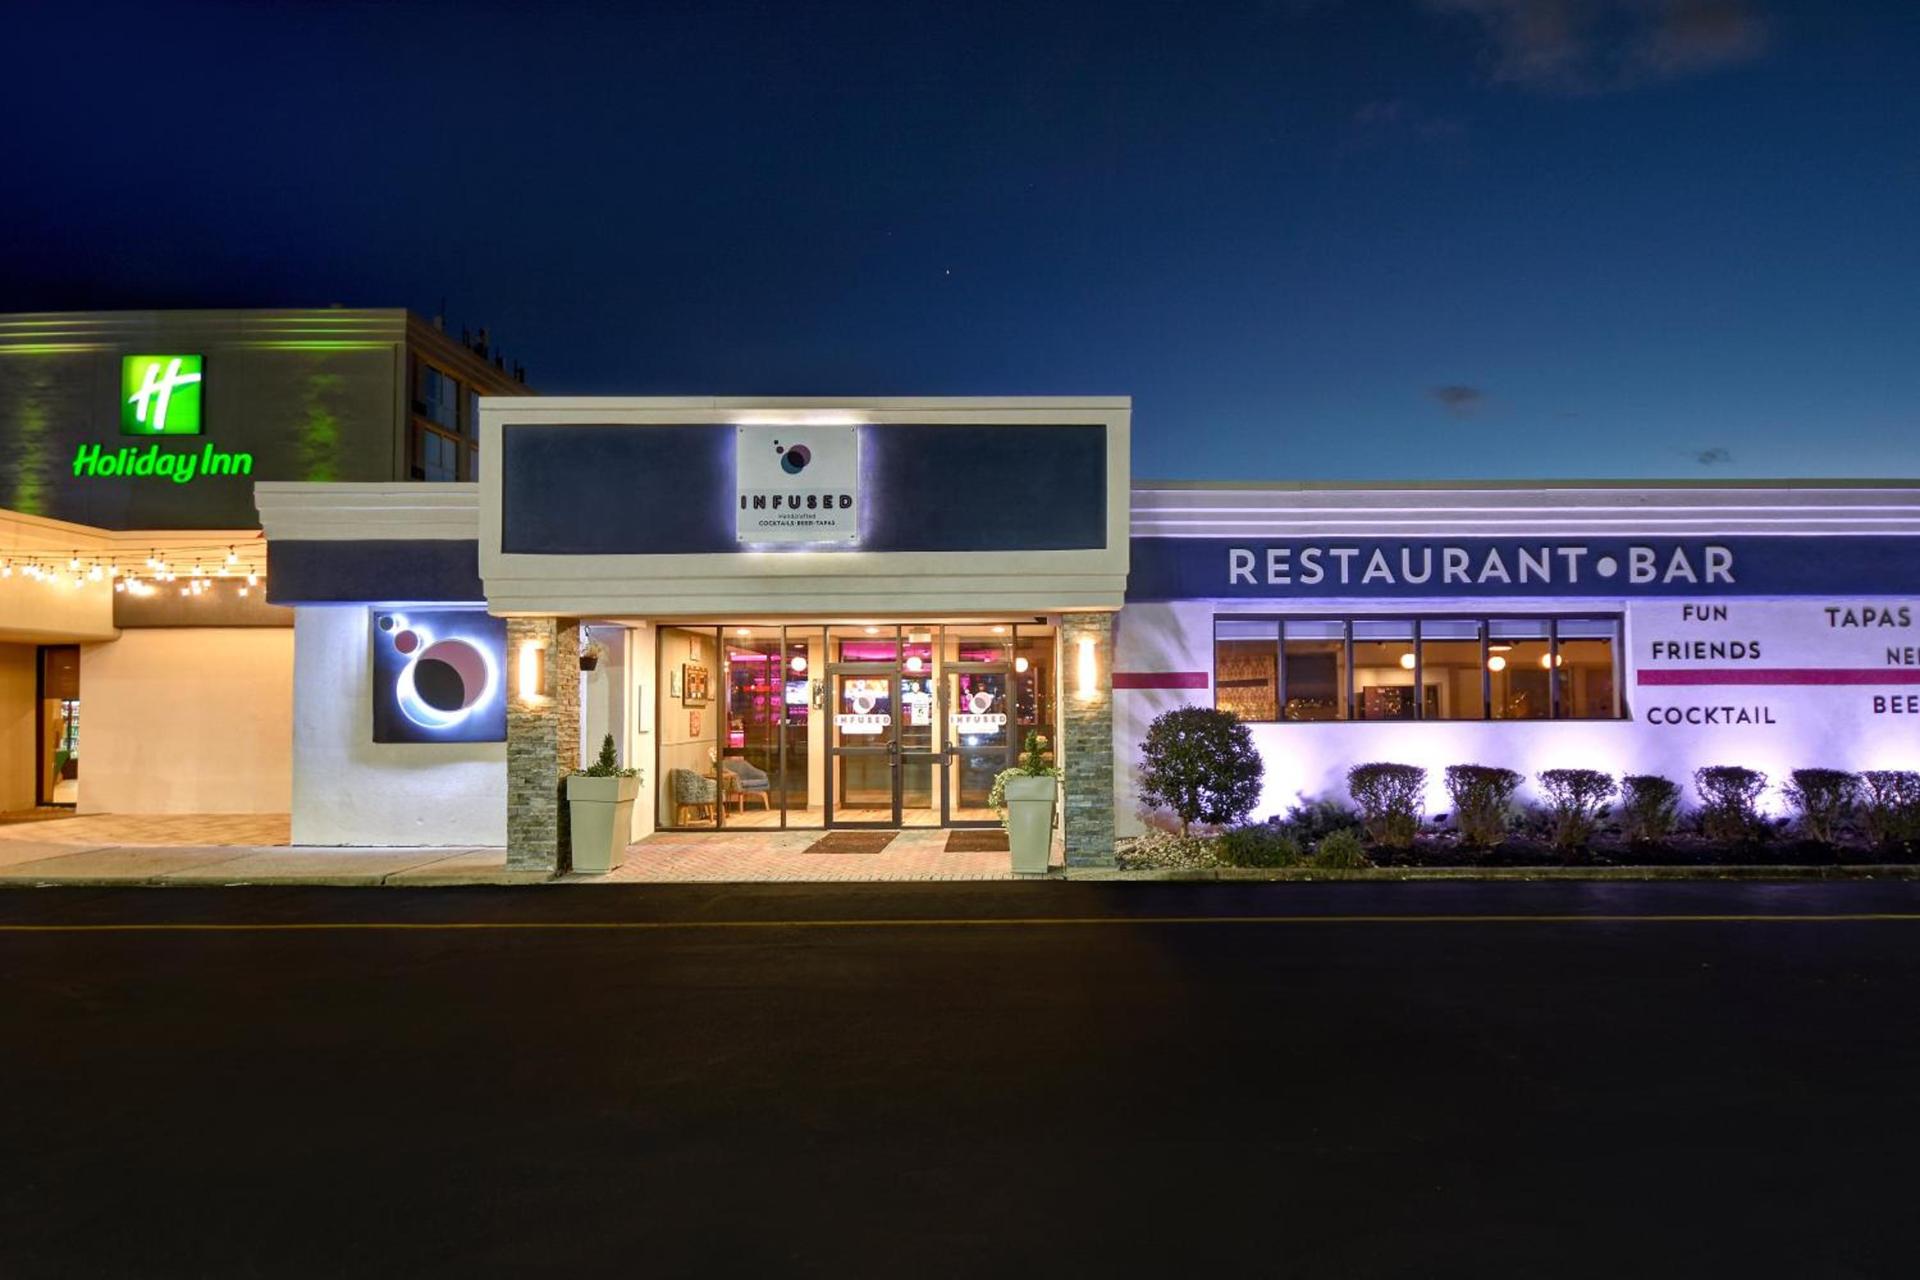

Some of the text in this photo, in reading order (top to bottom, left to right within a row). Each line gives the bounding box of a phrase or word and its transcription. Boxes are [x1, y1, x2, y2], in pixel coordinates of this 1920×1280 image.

[128, 358, 201, 430] H
[73, 443, 253, 483] Holiday Inn
[740, 494, 853, 510] INFUSED
[1229, 546, 1736, 585] RESTAURANT BAR
[1682, 604, 1728, 621] FUN
[1824, 607, 1912, 628] TAPAS
[1651, 641, 1761, 660] FRIENDS
[1886, 647, 1920, 665] NE
[1646, 706, 1777, 724] COCKTAIL
